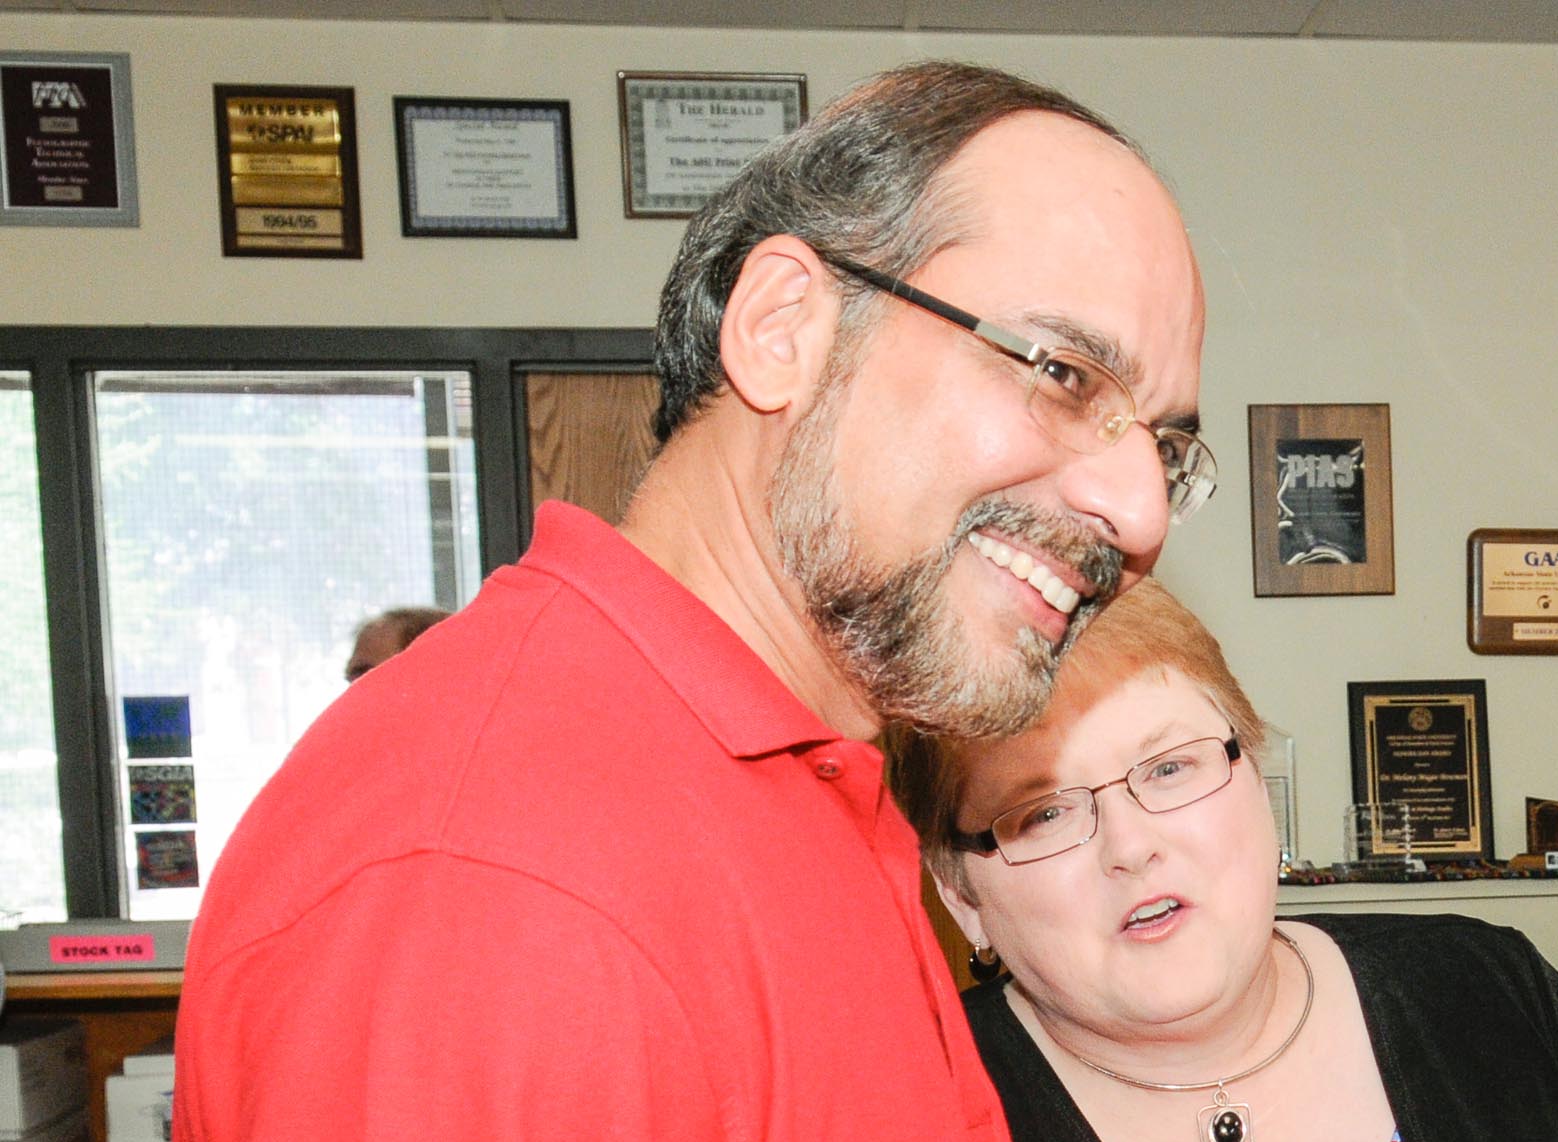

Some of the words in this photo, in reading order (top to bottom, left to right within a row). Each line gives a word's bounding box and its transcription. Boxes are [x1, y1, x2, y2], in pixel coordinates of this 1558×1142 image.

[239, 103, 326, 116] MEMBER
[710, 103, 765, 115] HERALD
[61, 946, 108, 957] STOCK
[115, 944, 143, 955] TAG
